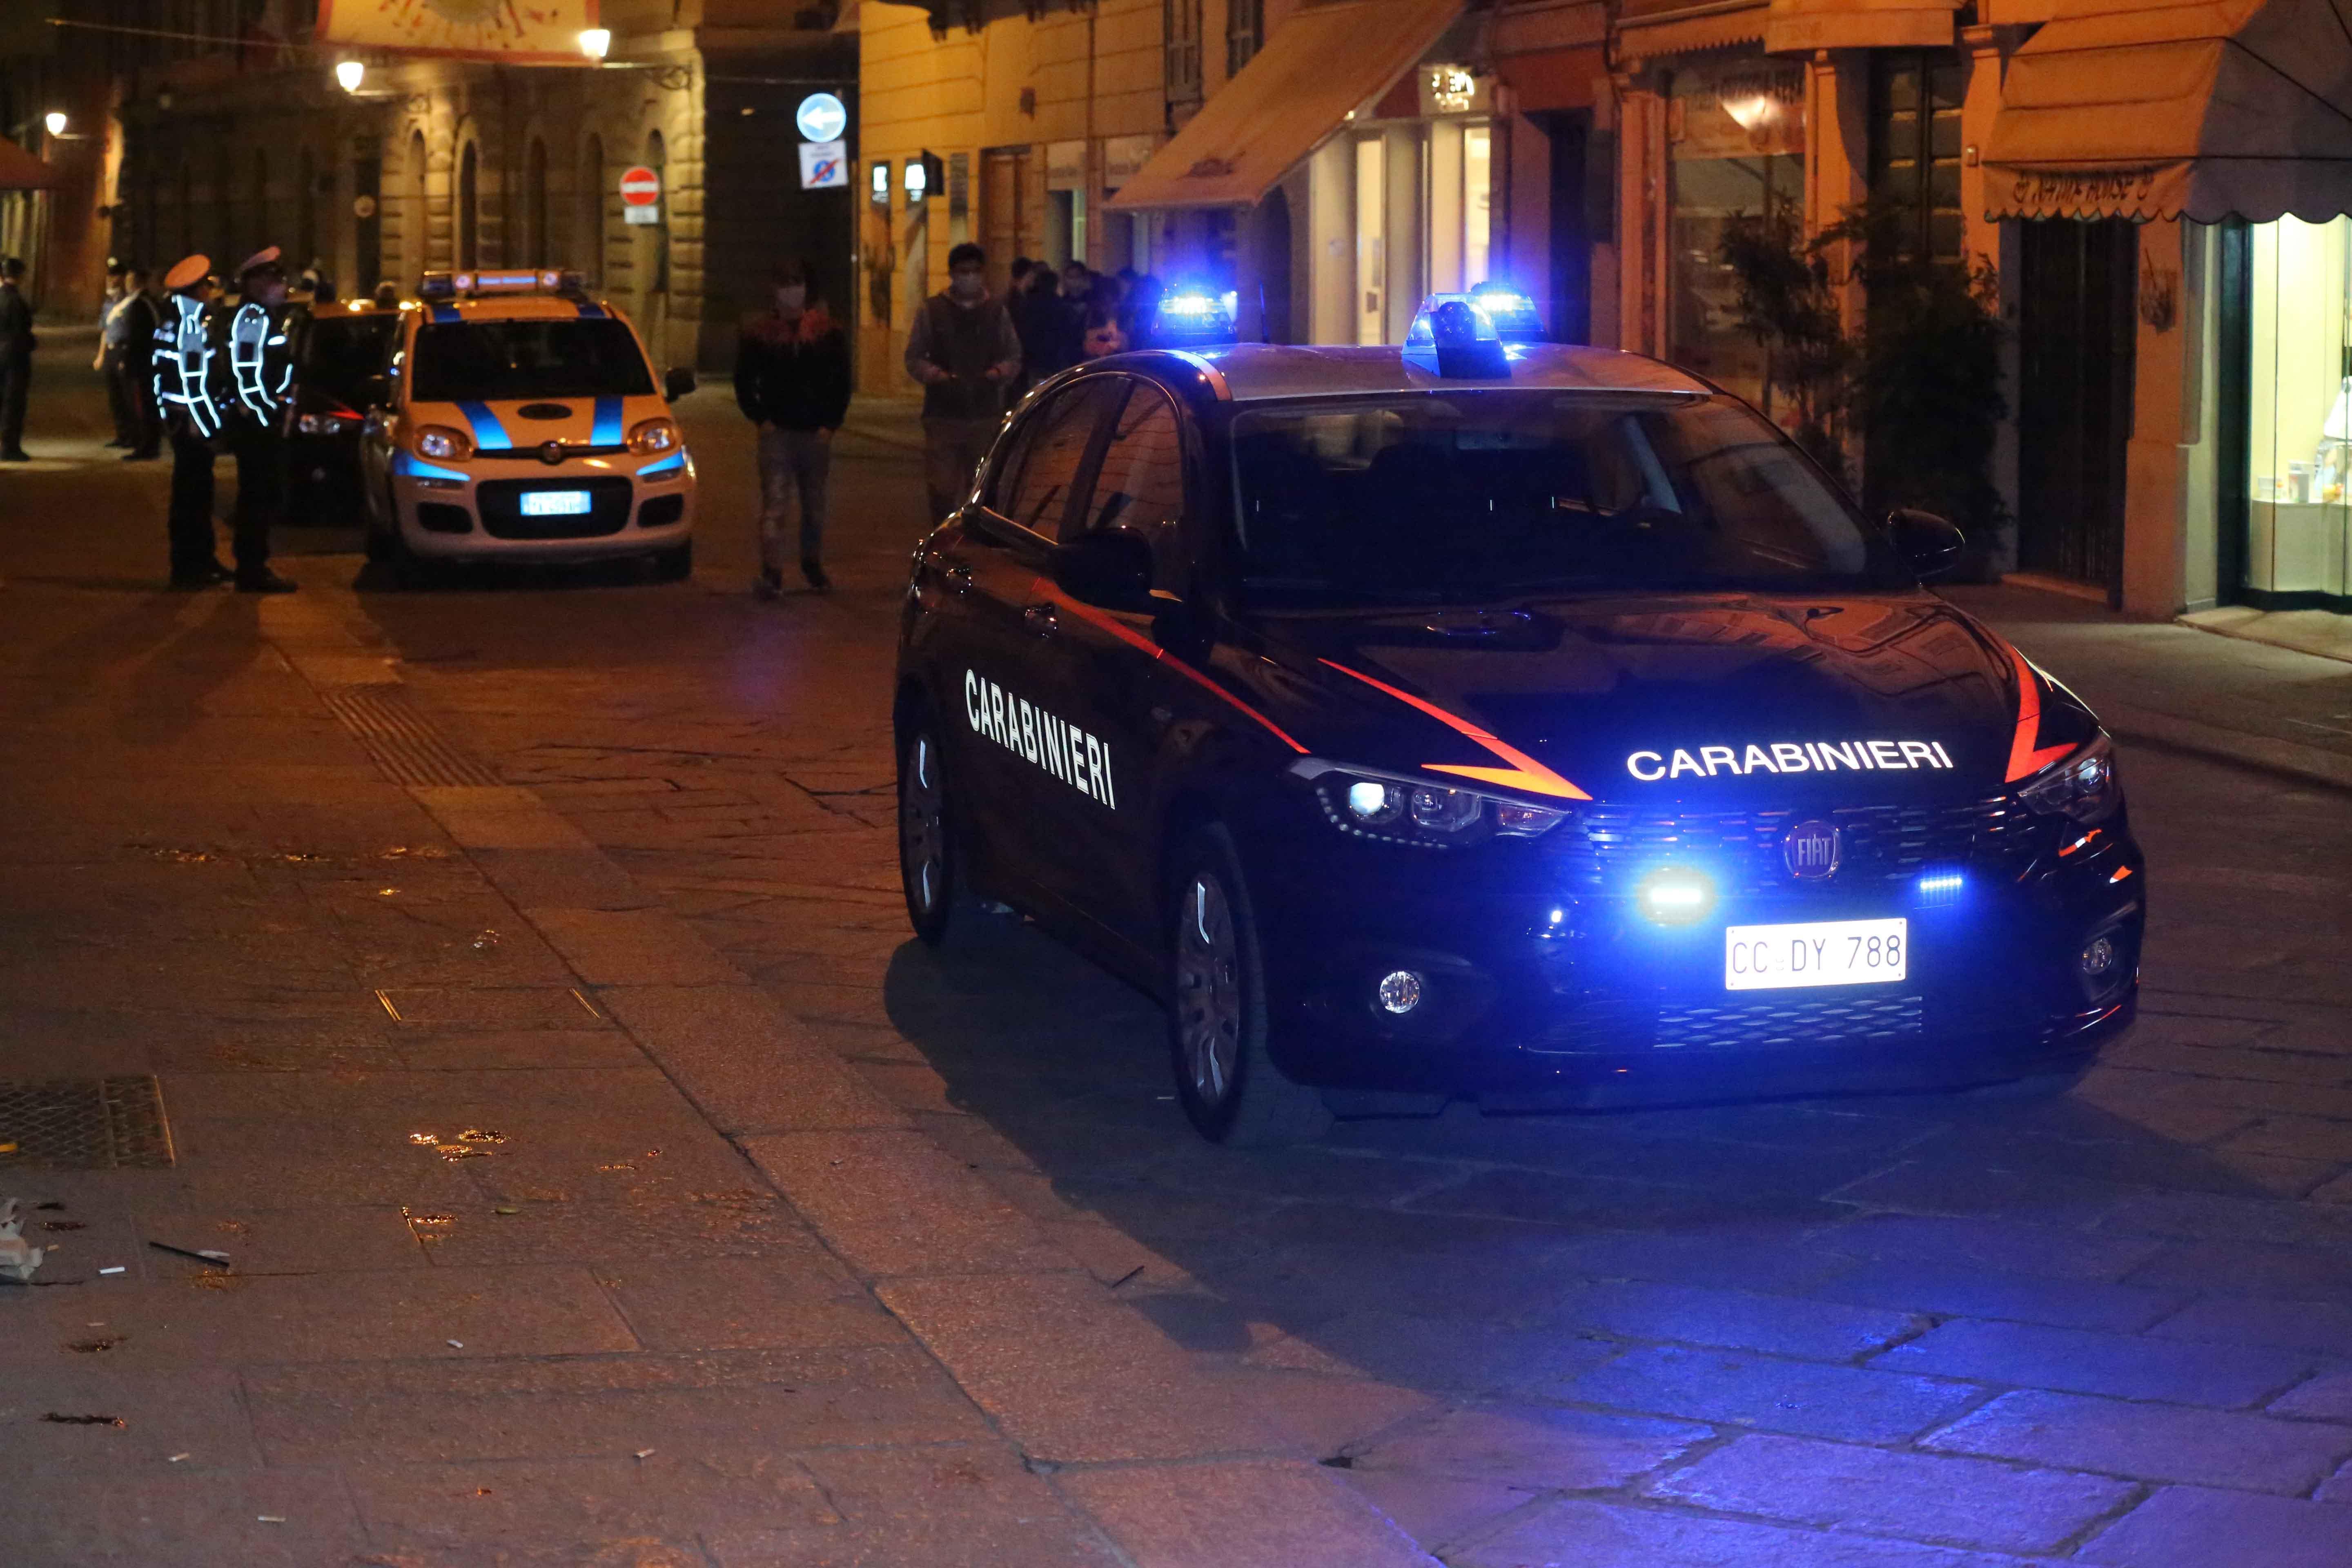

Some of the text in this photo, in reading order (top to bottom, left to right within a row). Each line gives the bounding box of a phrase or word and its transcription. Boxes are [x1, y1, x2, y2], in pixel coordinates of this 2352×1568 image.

[965, 668, 1116, 810] CARABINIERI
[1626, 740, 1954, 781] CARABINIERI
[1797, 834, 1832, 866] FIAT
[1732, 935, 1901, 974] CC DY 788
